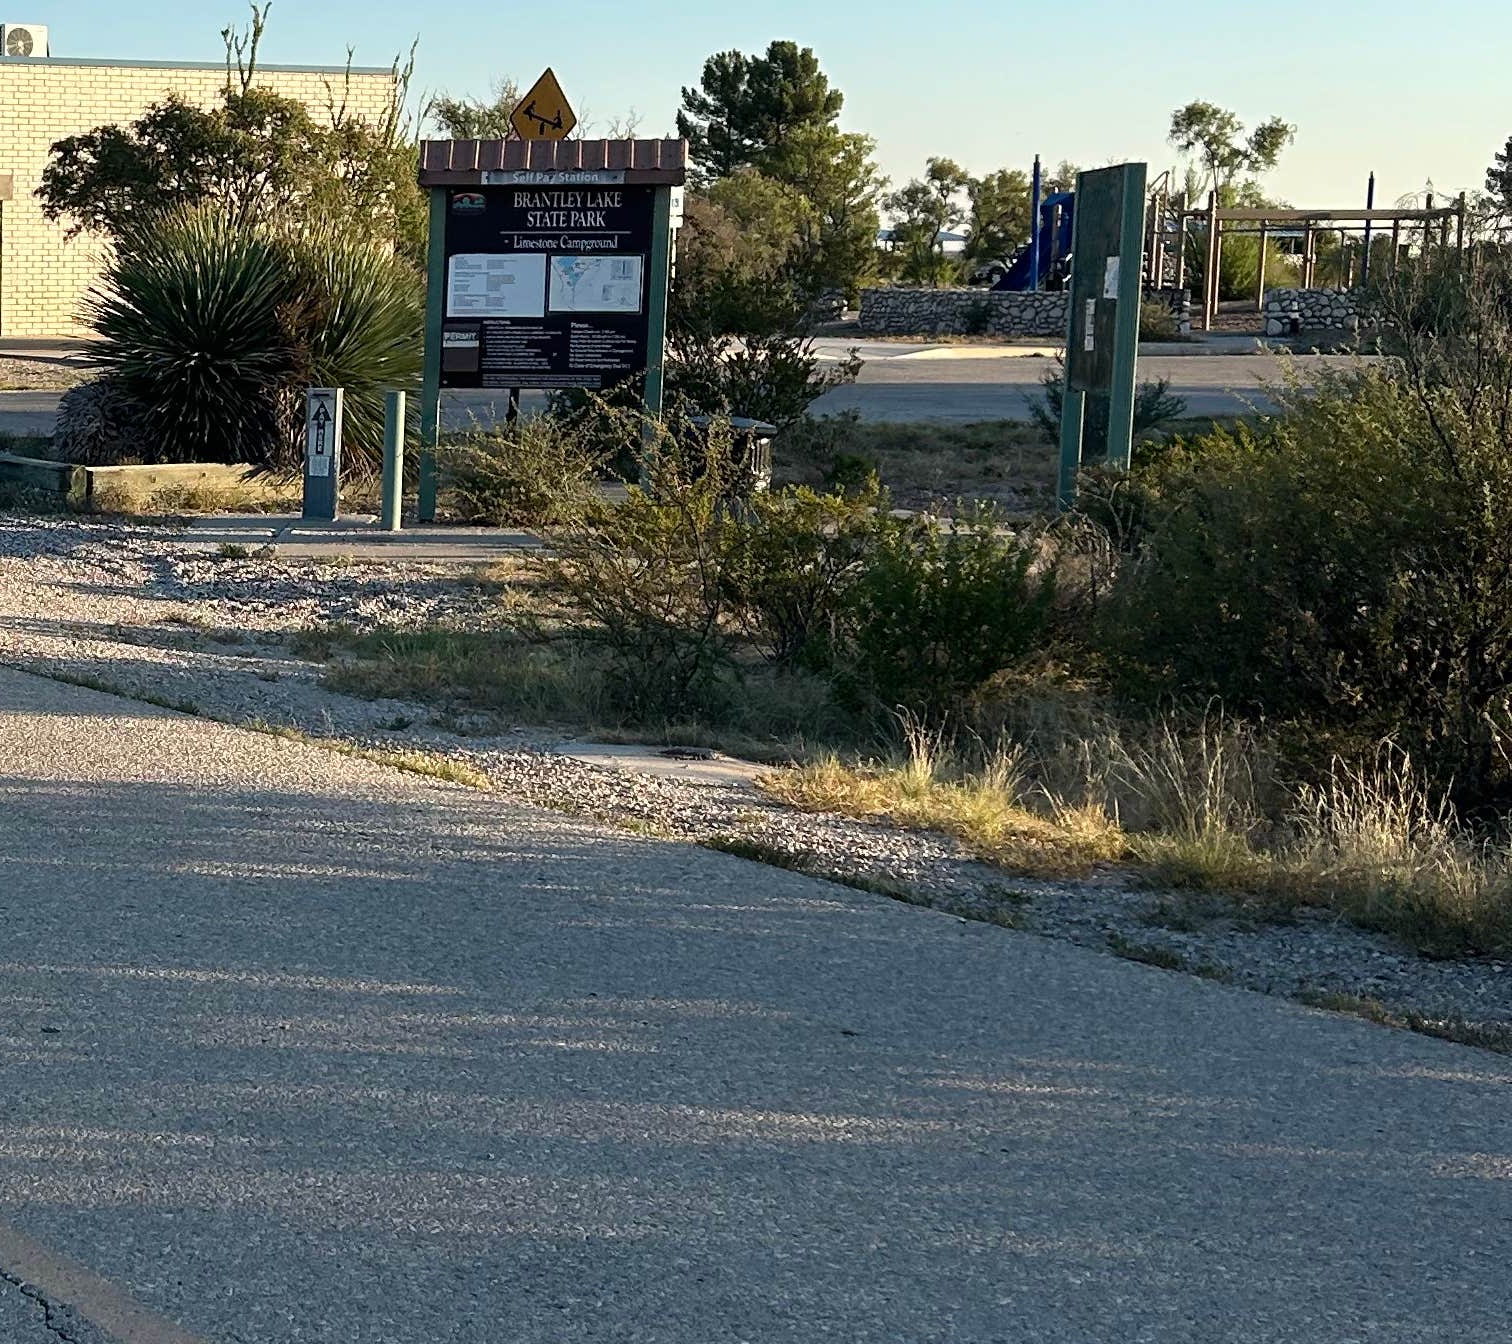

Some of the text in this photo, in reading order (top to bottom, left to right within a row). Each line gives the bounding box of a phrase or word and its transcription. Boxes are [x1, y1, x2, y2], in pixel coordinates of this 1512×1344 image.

[559, 171, 599, 183] Station
[513, 191, 623, 208] BRANTLEY LAKE
[526, 210, 606, 227] STATE PARK
[513, 234, 618, 252] Limestone Campground
